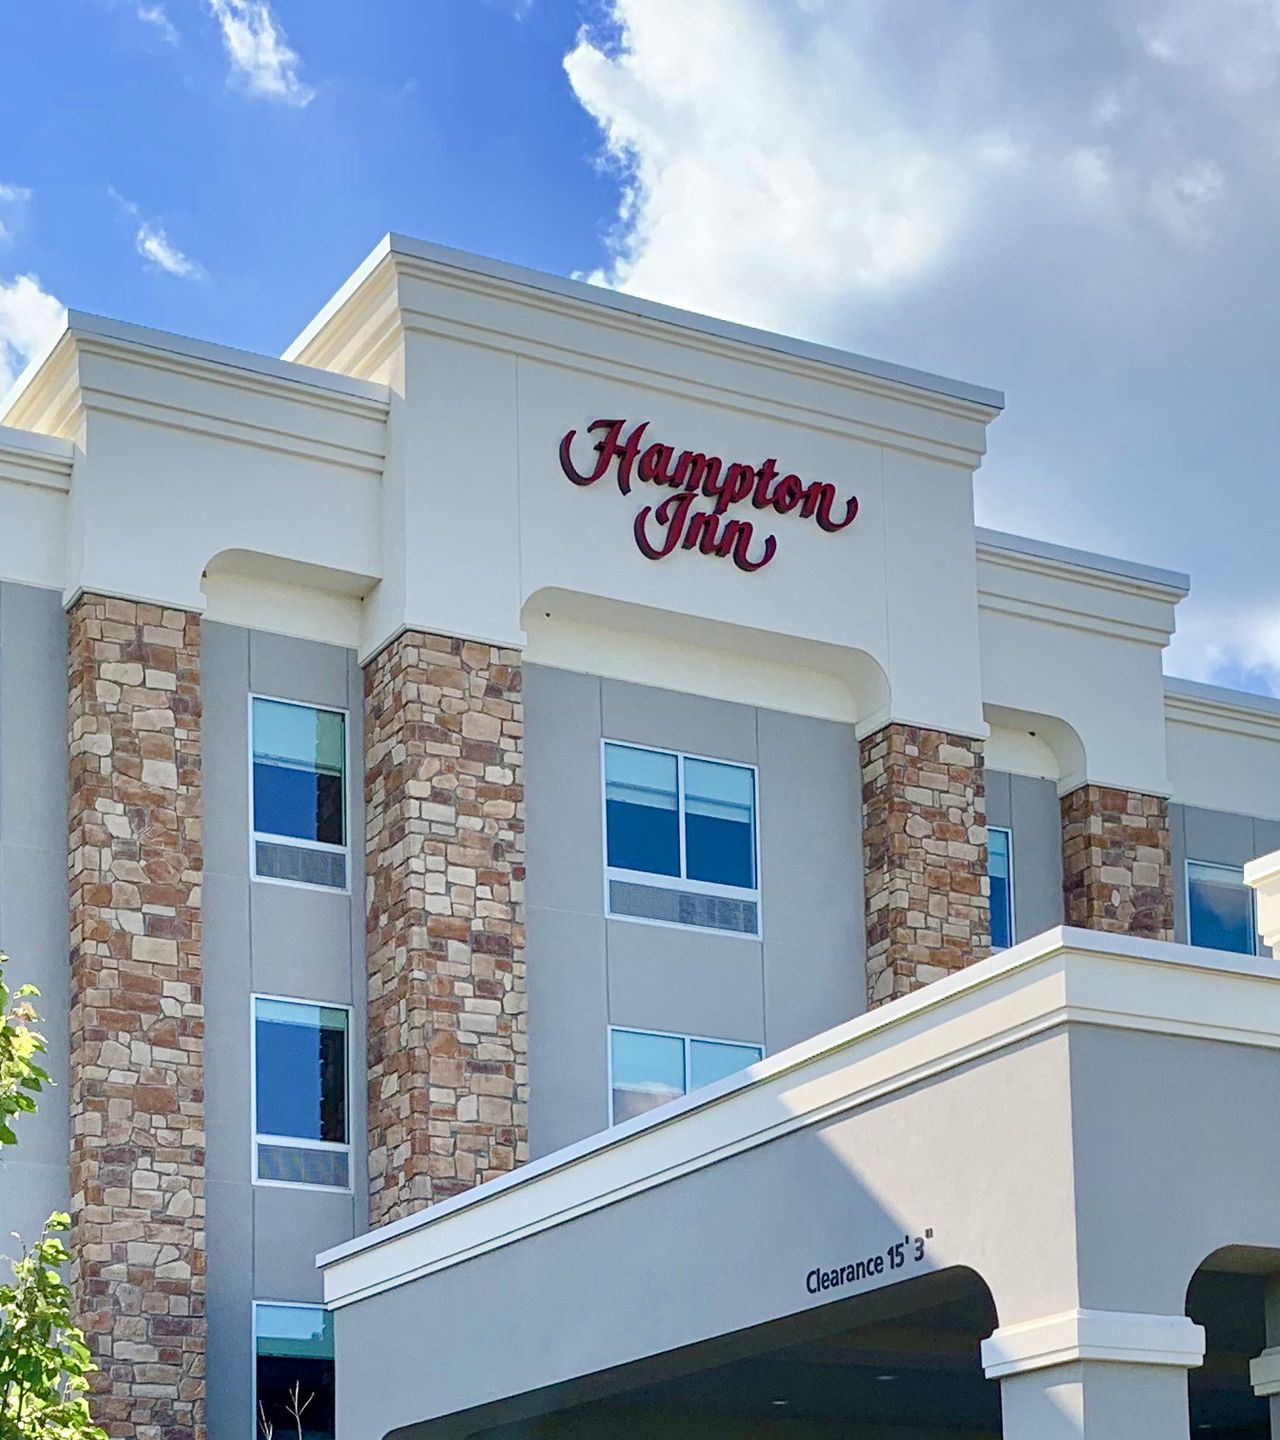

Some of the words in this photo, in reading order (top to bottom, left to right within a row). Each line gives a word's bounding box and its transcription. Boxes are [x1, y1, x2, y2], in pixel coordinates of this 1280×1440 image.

[559, 419, 859, 532] Hampton
[634, 492, 777, 572] Inn
[806, 1255, 884, 1294] Clearance
